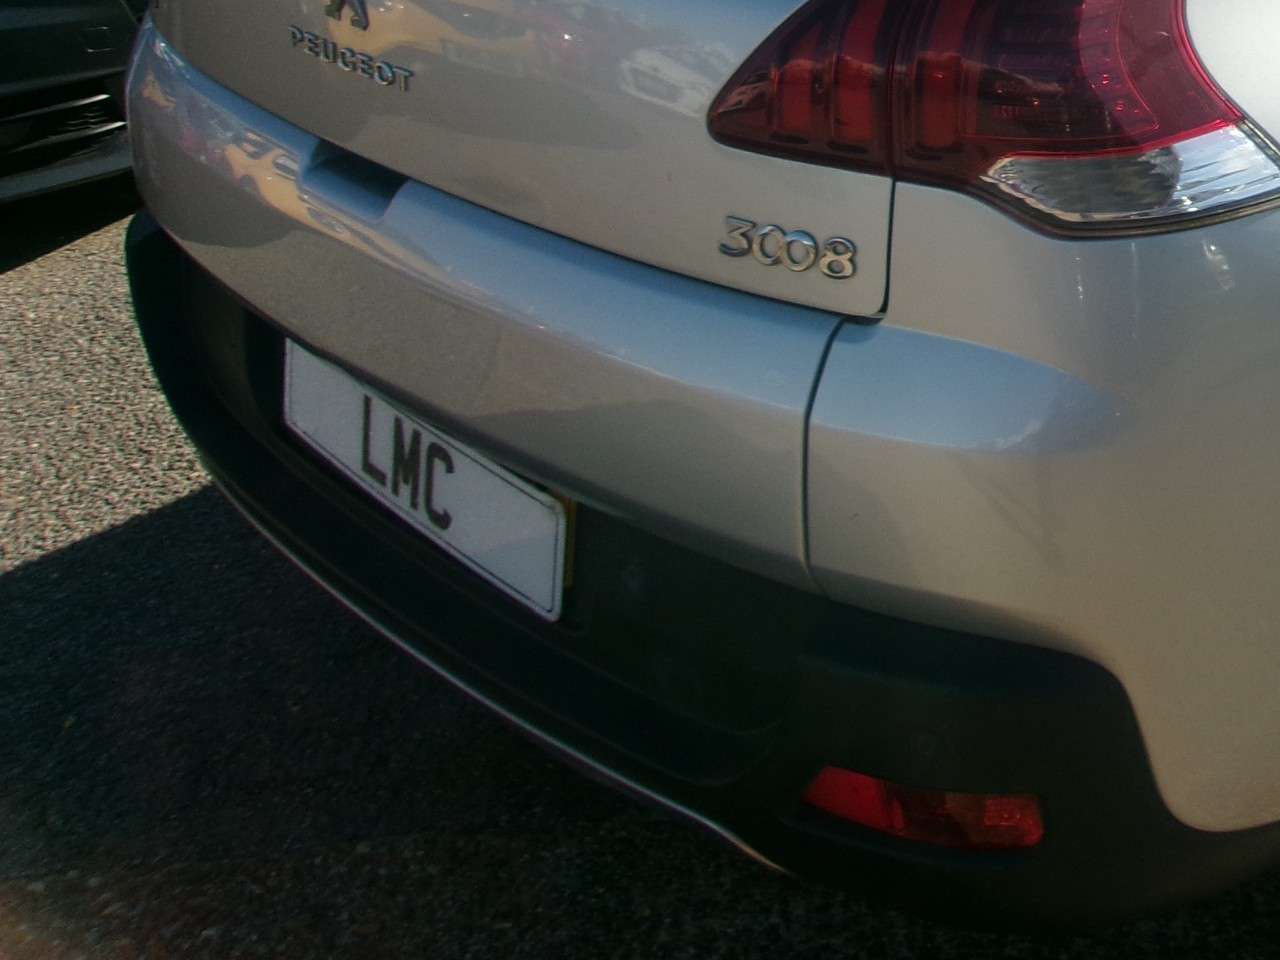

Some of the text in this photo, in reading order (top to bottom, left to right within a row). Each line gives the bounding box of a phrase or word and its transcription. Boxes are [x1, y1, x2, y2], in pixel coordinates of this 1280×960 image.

[288, 24, 415, 91] PEUGEOT
[719, 215, 857, 280] 3008
[361, 394, 455, 531] LMC
